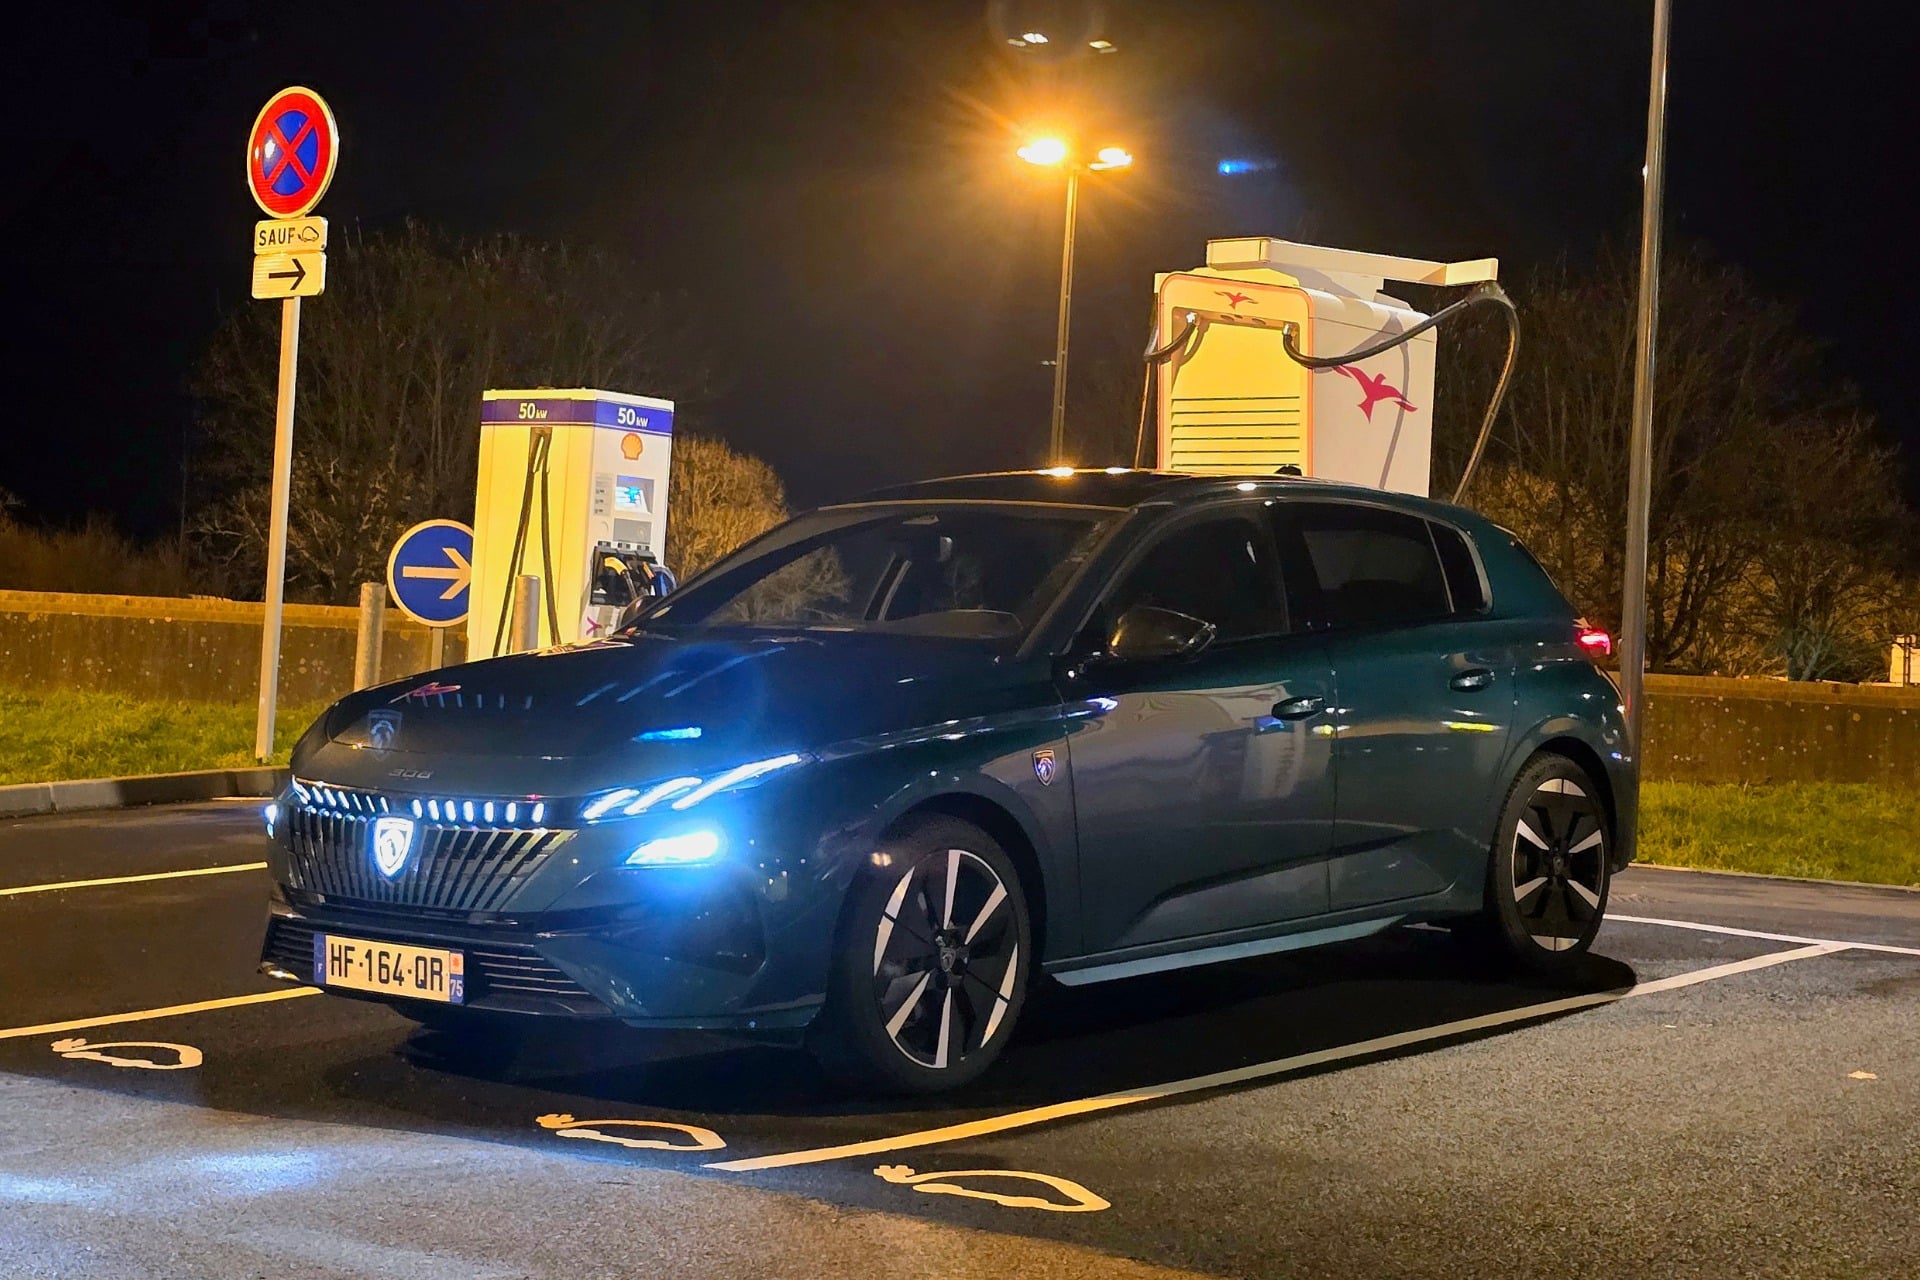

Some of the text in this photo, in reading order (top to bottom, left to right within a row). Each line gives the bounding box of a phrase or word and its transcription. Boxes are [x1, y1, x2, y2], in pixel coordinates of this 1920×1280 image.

[258, 227, 295, 246] SAUF
[317, 963, 323, 973] F
[330, 943, 443, 992] HF-164-QR
[450, 979, 464, 997] 75
